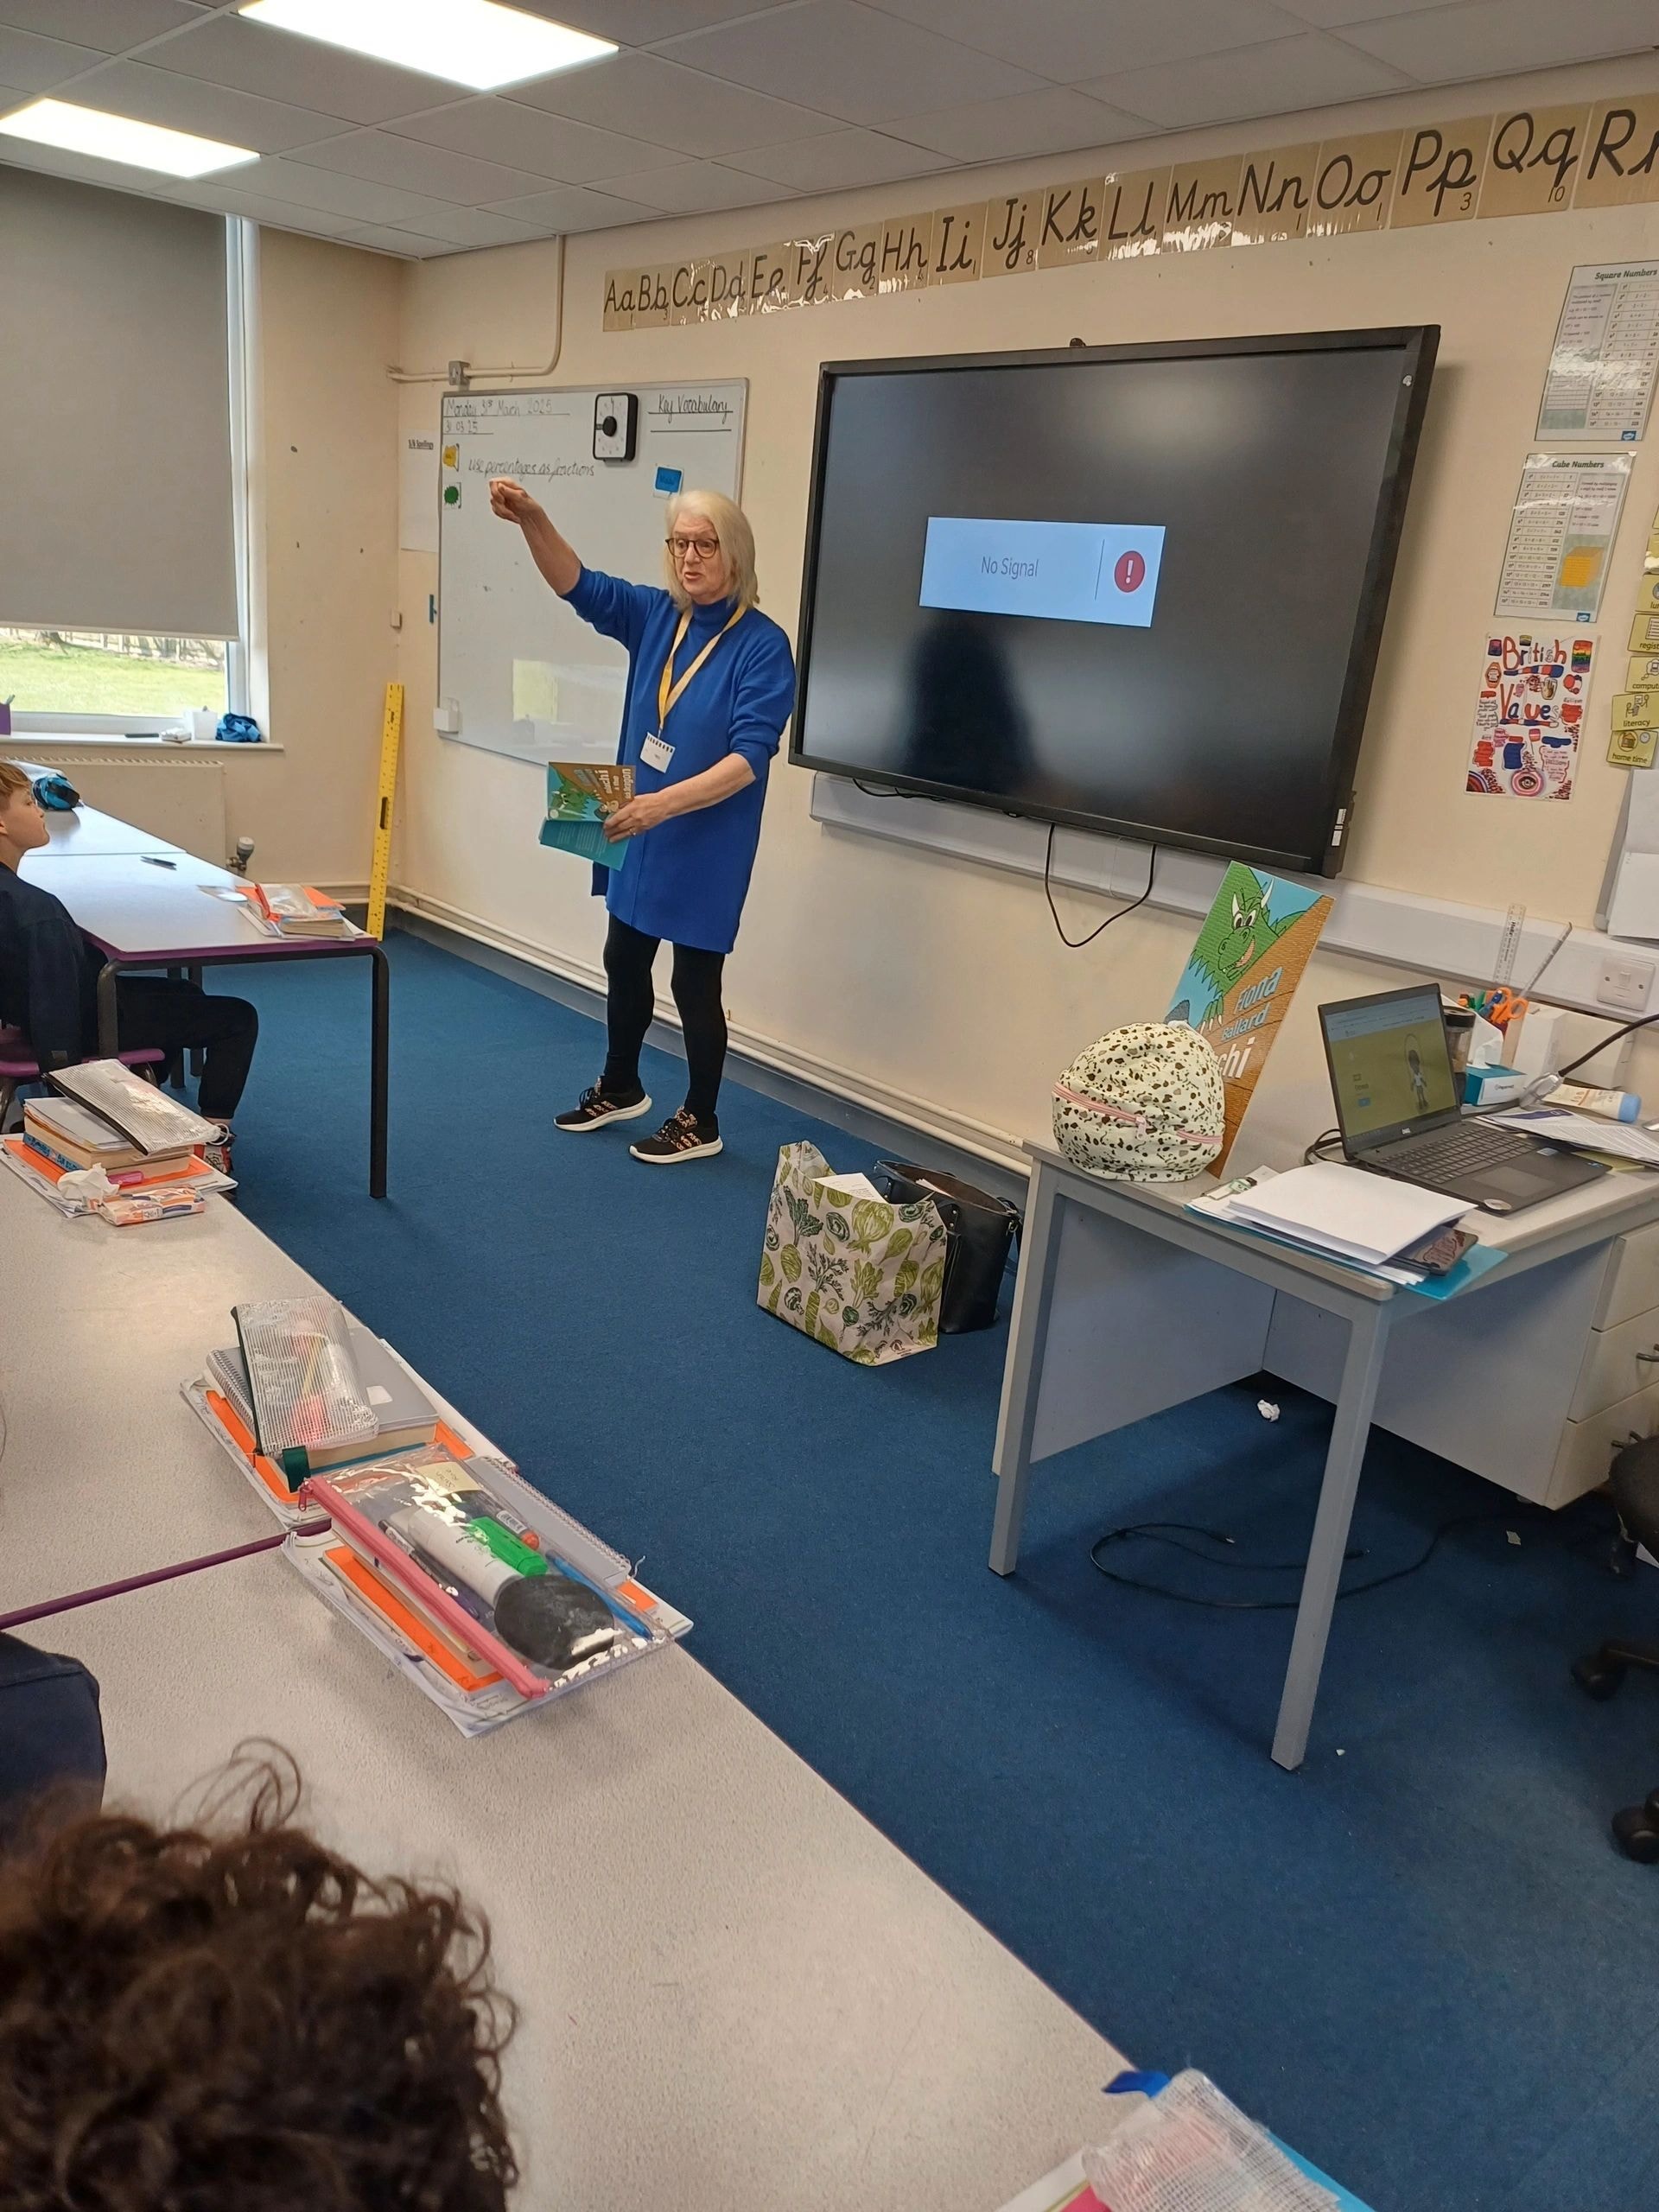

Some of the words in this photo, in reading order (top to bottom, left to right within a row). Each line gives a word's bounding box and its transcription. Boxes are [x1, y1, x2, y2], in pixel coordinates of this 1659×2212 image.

[1459, 192, 1472, 212] 3
[1548, 186, 1565, 203] 10
[604, 279, 635, 312] Aa
[638, 273, 669, 311] Bb
[672, 267, 708, 307] Cc
[711, 260, 746, 302] Dd
[836, 230, 876, 285] Gg
[881, 226, 927, 273] Hh
[935, 216, 972, 272] Ii
[993, 197, 1027, 269] Jj
[1041, 187, 1097, 245] Kk
[1108, 181, 1154, 240] Ll
[1166, 179, 1233, 224] Mm
[1236, 161, 1308, 216] Nn
[1316, 154, 1391, 210] Oo
[1402, 130, 1477, 217] Pp
[1492, 111, 1578, 188] Qq
[1594, 272, 1622, 282] Square
[1624, 269, 1657, 278] Numbers
[658, 393, 673, 423] Key
[677, 394, 728, 424] Vocabulary
[981, 556, 997, 575] No
[1001, 557, 1039, 580] Signal
[1503, 636, 1567, 671] British
[1623, 719, 1650, 728] literacy
[1612, 753, 1631, 762] home
[1632, 754, 1648, 764] time
